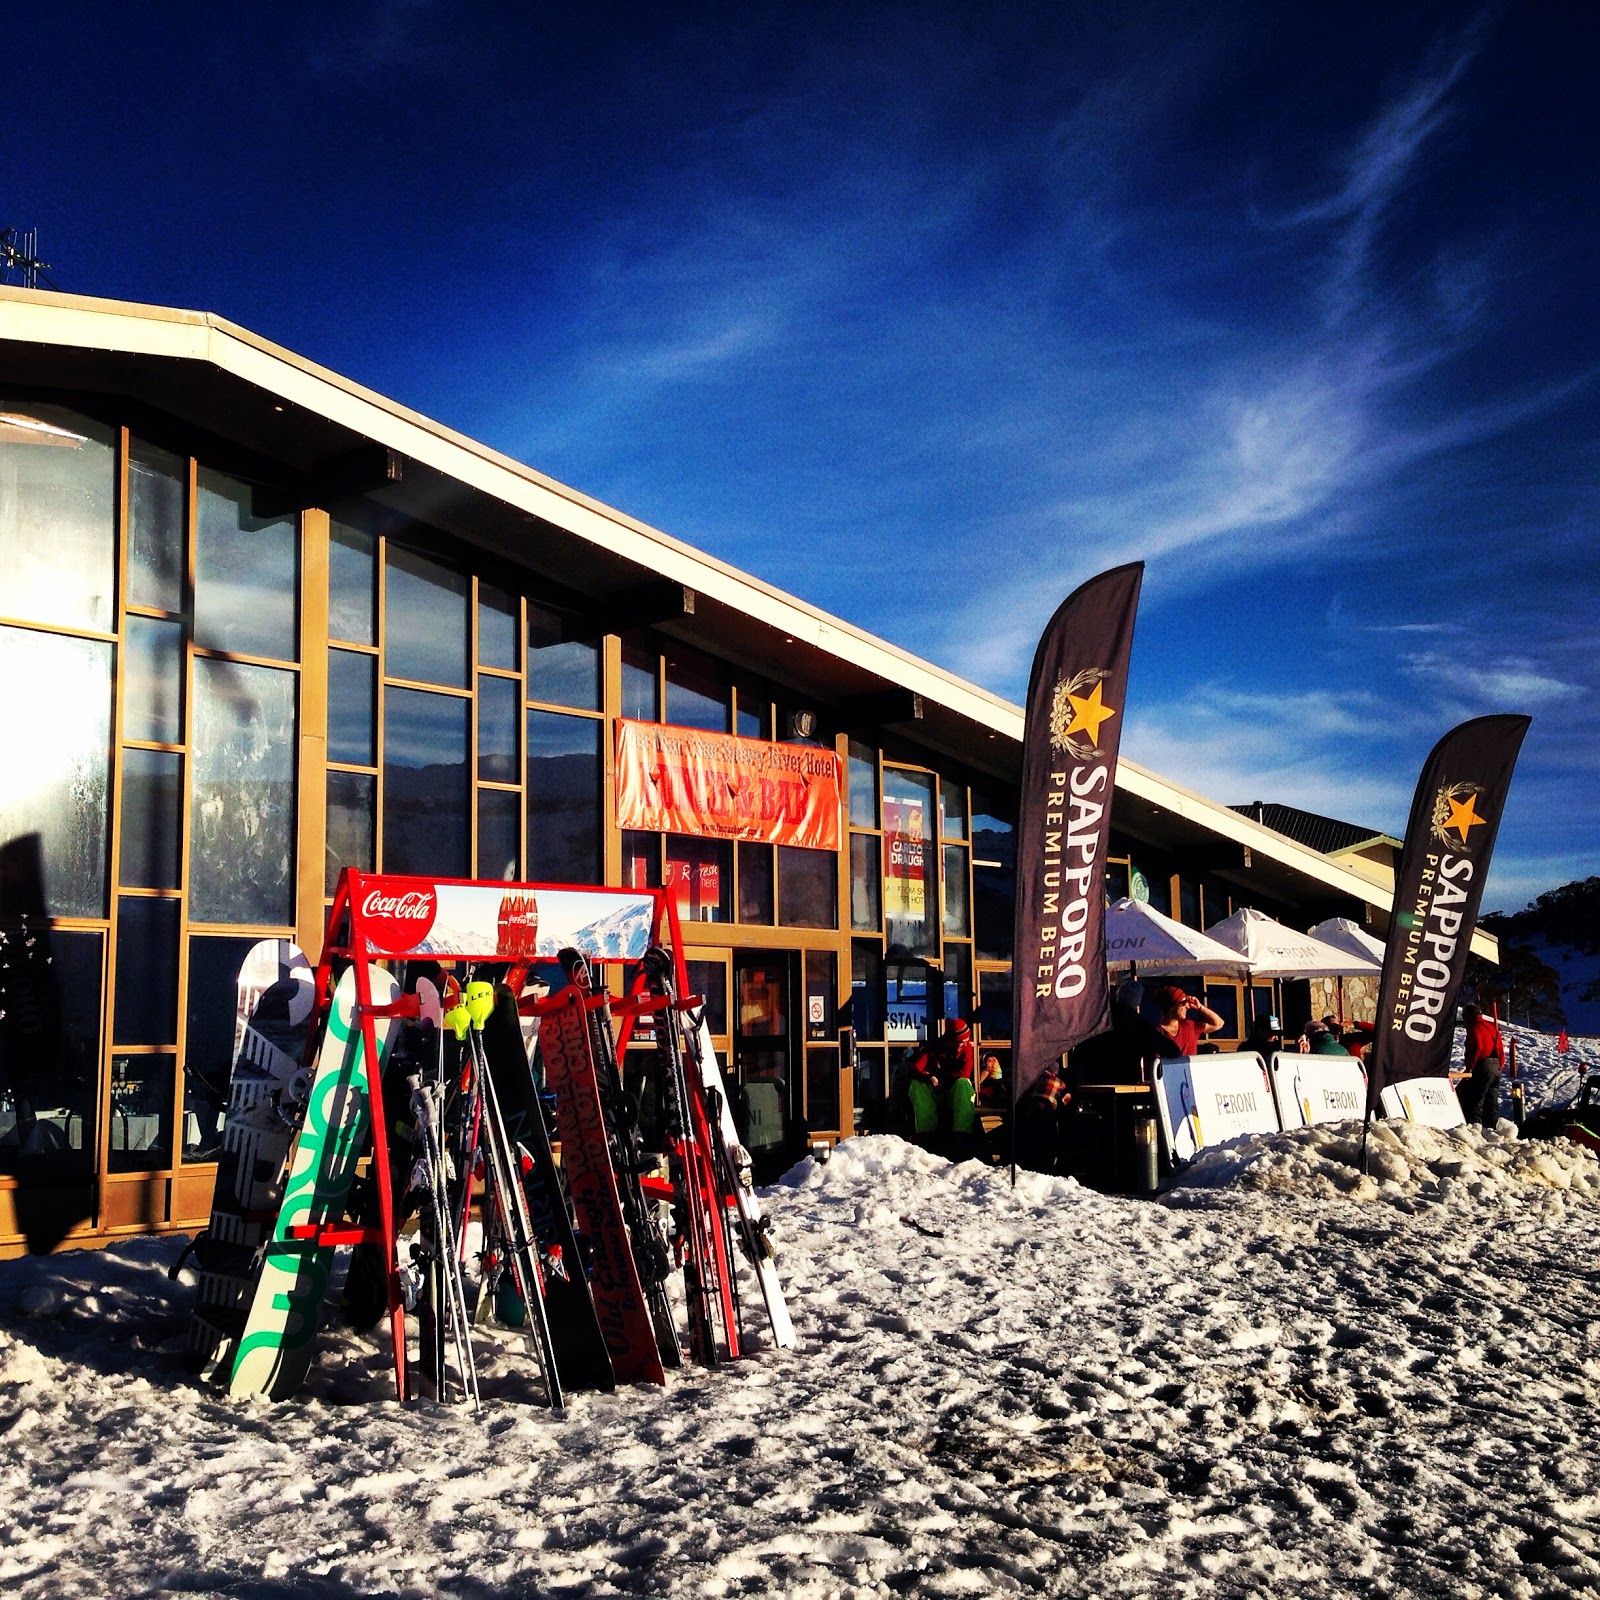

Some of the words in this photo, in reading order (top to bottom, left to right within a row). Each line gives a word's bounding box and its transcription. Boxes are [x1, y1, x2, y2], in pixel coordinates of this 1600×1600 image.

[721, 741, 766, 773] Snowy
[768, 746, 803, 773] River
[806, 753, 835, 779] Hotel
[737, 774, 754, 818] &
[759, 777, 810, 825] BAR
[892, 841, 924, 855] CARLTO
[1044, 772, 1066, 915] PREMIUM
[701, 877, 717, 888] here
[1055, 765, 1108, 999] SAPPORO
[362, 890, 435, 919] Coca-Cola
[1404, 853, 1439, 965] PREMIUM
[1036, 926, 1057, 999] BEER
[1266, 946, 1320, 958] PERONI
[1405, 853, 1474, 1043] SAPPORO
[1392, 973, 1414, 1032] BEER
[563, 1006, 587, 1071] CARE
[1214, 1091, 1258, 1116] PERONI
[1323, 1089, 1358, 1110] PERONI
[1418, 1087, 1448, 1106] PERONI
